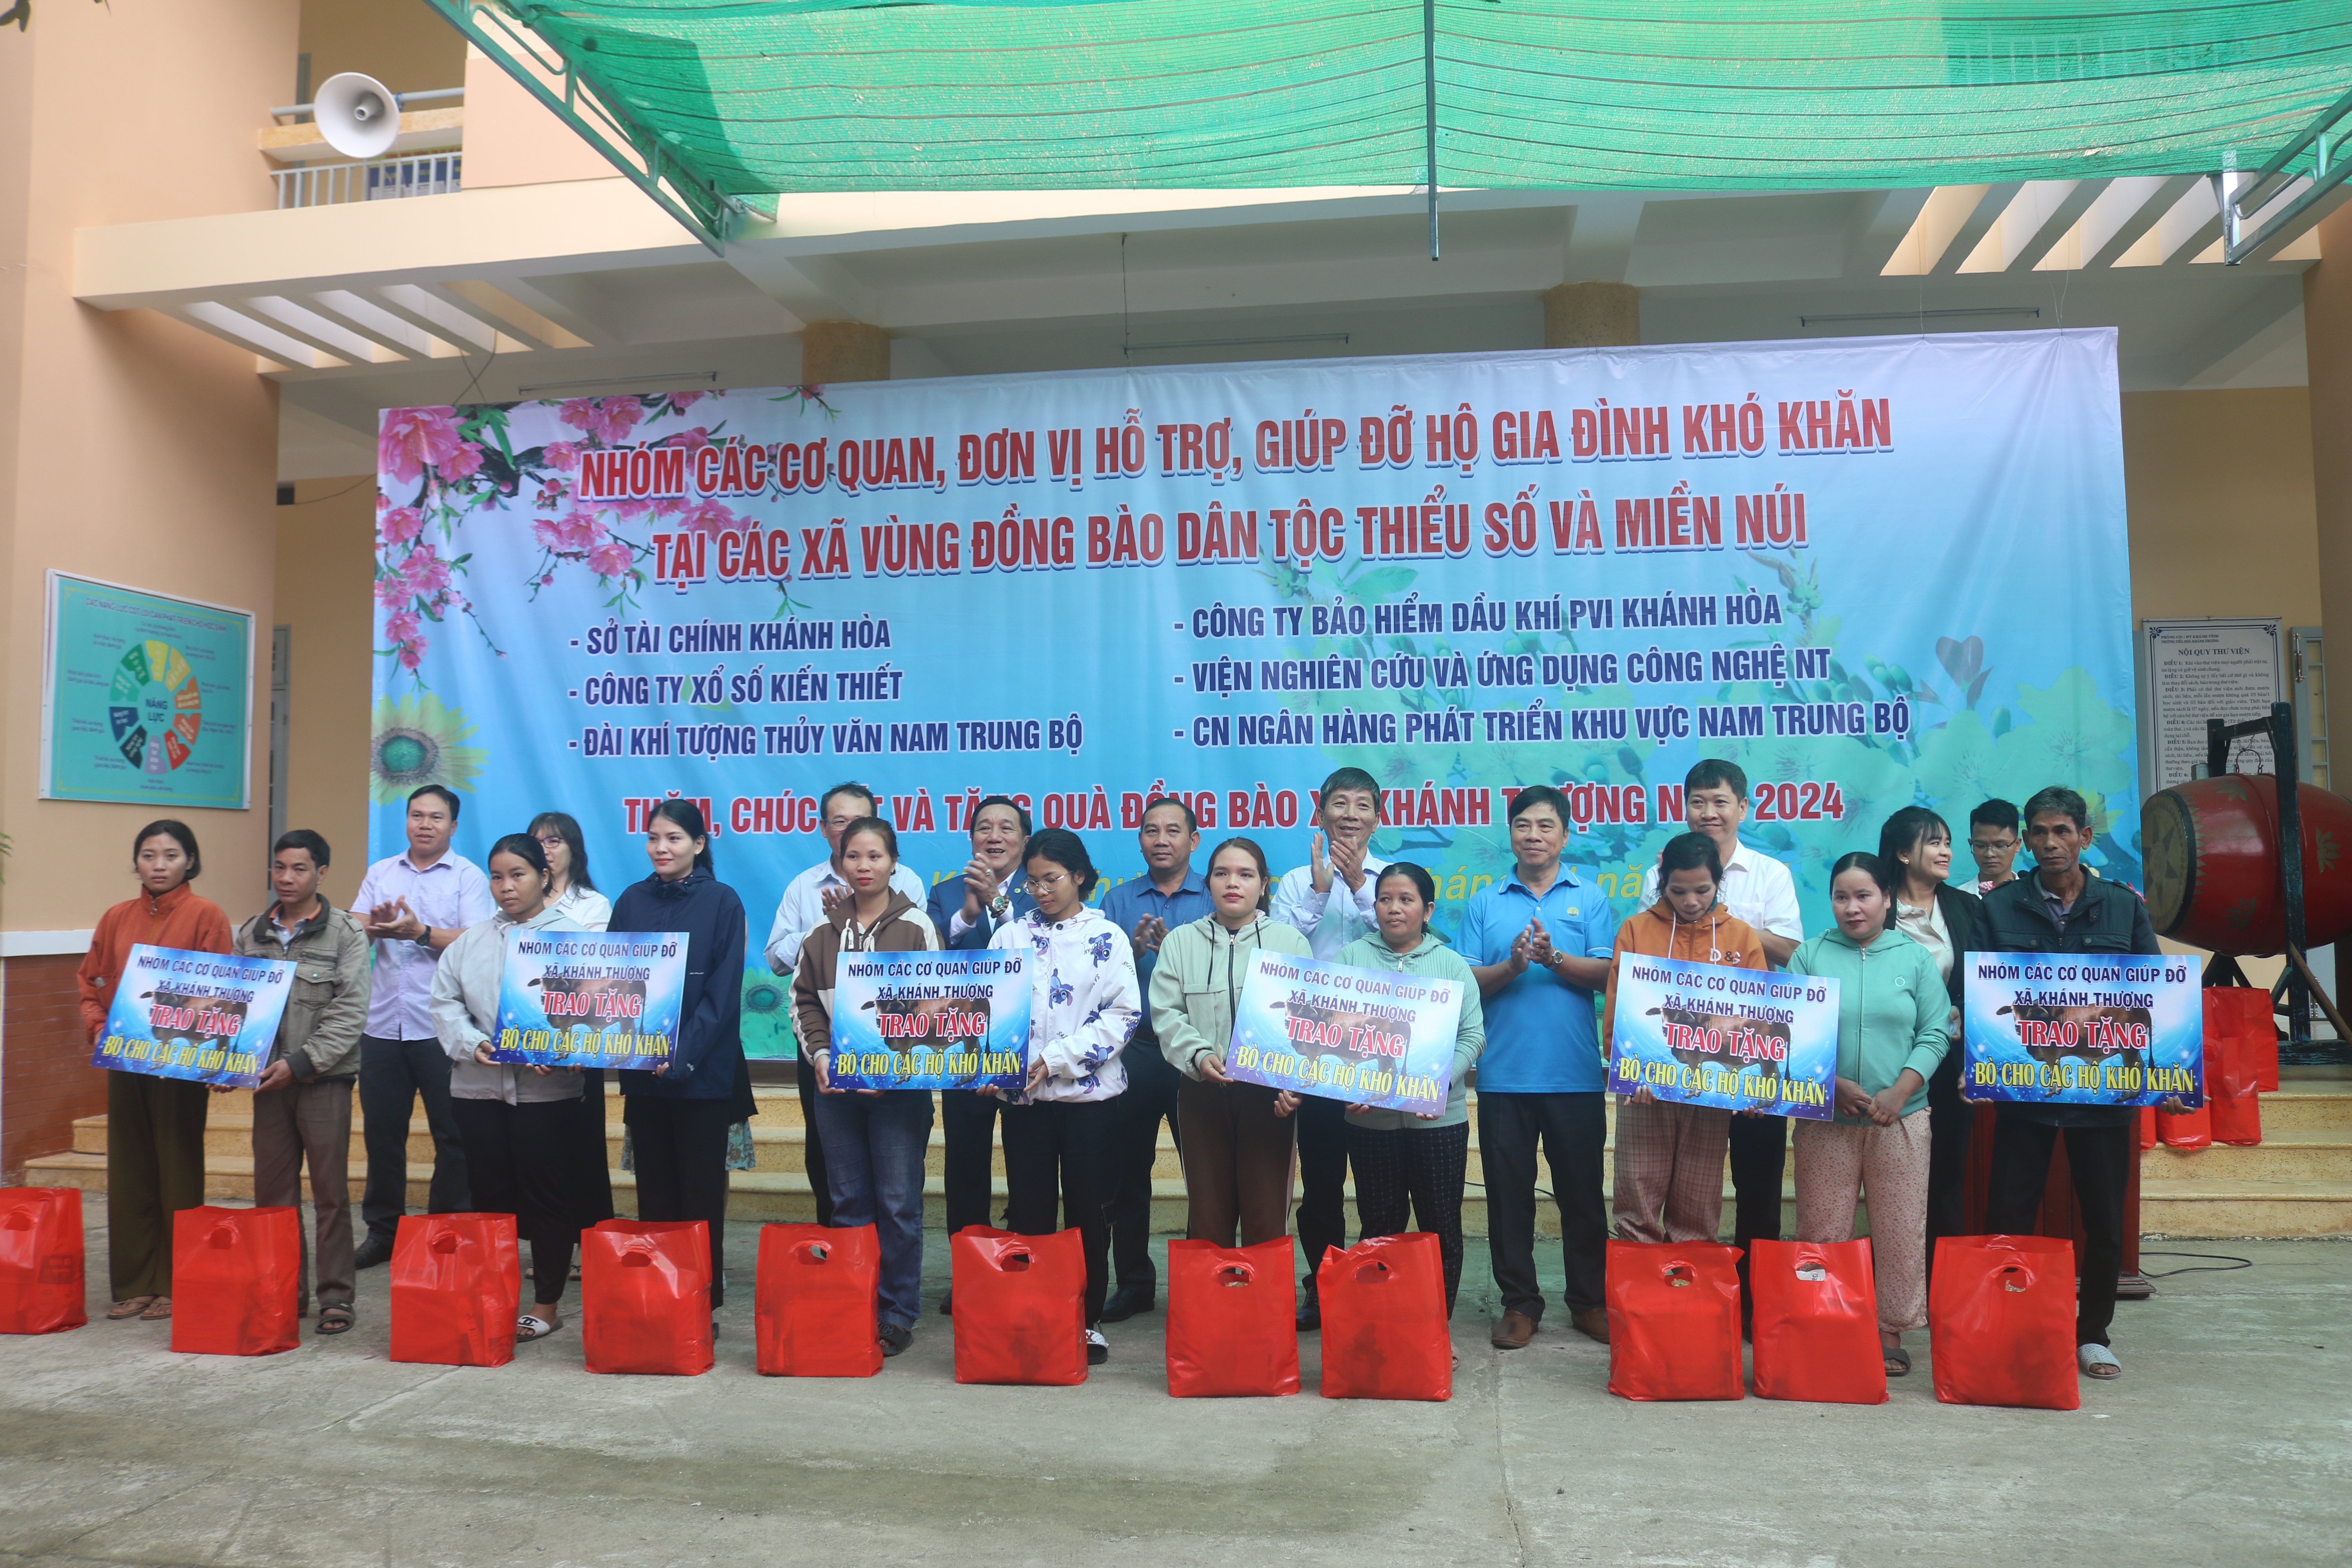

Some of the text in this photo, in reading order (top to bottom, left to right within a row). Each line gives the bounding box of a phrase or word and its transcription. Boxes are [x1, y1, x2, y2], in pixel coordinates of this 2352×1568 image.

[580, 389, 1891, 498] NHÓM CÁC CƠ QUAN, ĐƠN VỊ HỖ TRỢ, GIÚP ĐỠ HỘ GIA ĐÌNH KHÓ KHĂN
[653, 480, 1806, 589] TẠI CÁC XÃ VÙNG ĐỒNG BÀO DÂN TỘC THIỂU SỐ VÀ MIỀN NÚI
[1192, 587, 1782, 638] CÔNG TY BẢO HIỂM DẦU KHÍ PVI KHÁNH HÒA
[587, 613, 890, 655] SỞ TÀI CHÍNH KHÁNH HÒA
[2178, 648, 2192, 656] NỘI
[2230, 647, 2250, 655] VIỆN
[585, 662, 903, 705] CÔNG TY XỔ SỐ KIẾN THIẾT
[1192, 643, 1830, 698] VIỆN NGHIÊN CỨU VÀ ỨNG DỤNG CÔNG NGHỆ NT
[584, 713, 1082, 761] ĐÀI KHÍ TƯỢNG THỦY VĂN NAM TRUNG BỘ
[1193, 696, 1909, 746] CN NGÂN HÀNG PHÁT TRIỂN KHU VỰC NAM TRUNG BỘ
[730, 791, 818, 833] CHÚC
[892, 789, 934, 832] VÀ
[1043, 786, 1111, 829] QUÀ
[1229, 783, 1297, 828] BÀO
[1755, 783, 1844, 821] 2024
[848, 957, 1022, 977] NHÓM CÁC CƠ QUAN GIÚP ĐỠ
[543, 988, 641, 1023] TRAO TẶNG
[878, 982, 993, 1001] XÃ KHÁNH THƯỢNG
[149, 1004, 242, 1039] TRAO TẶNG
[878, 1007, 985, 1042] TRAO TẶNG
[1286, 1016, 1405, 1058] TRAO TẶNG
[1664, 1022, 1786, 1063] TRAO TẶNG
[2017, 1016, 2147, 1054] TRAO TẶNG
[837, 1046, 1020, 1080] BÒ CHO CÁC HỘ KHÓ KHĂN
